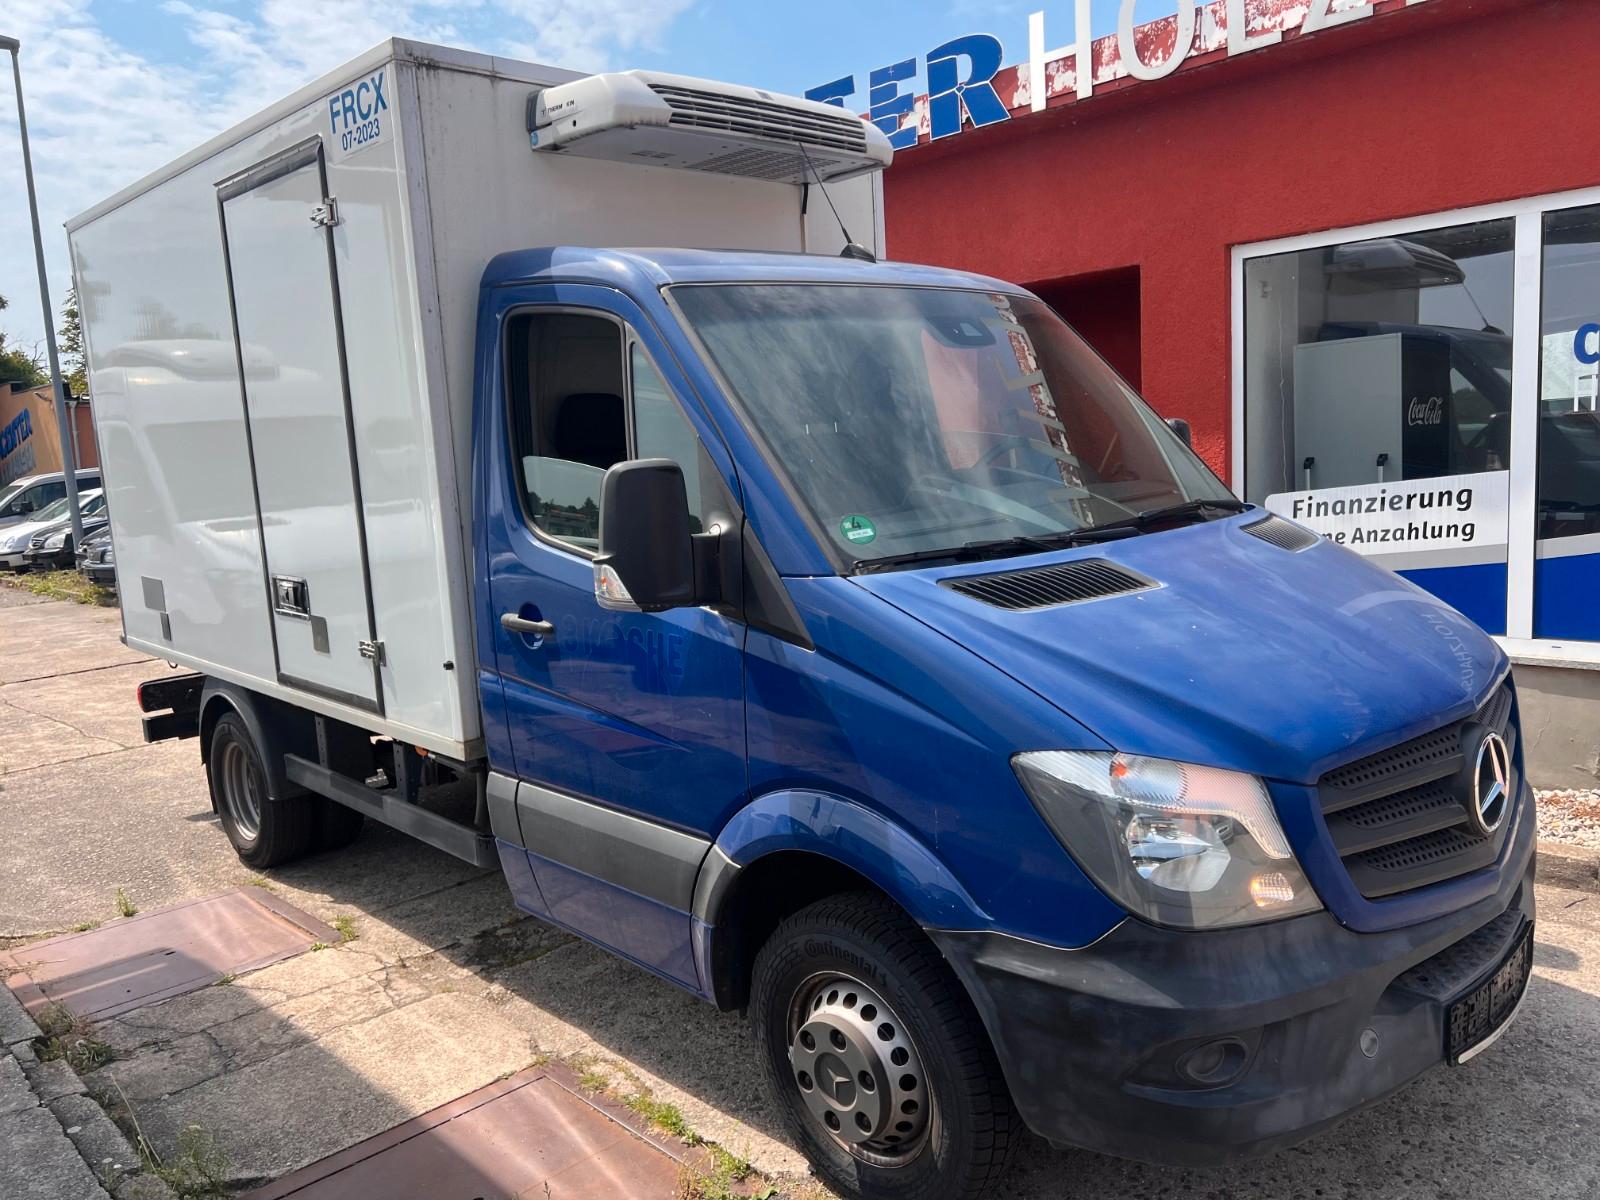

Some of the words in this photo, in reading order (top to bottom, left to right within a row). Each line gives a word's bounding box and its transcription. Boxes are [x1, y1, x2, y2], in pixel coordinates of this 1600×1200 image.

[329, 72, 387, 134] FRCX
[342, 118, 380, 151] 07-2023
[1293, 488, 1473, 519] Finanzierung
[1351, 521, 1476, 545] Anzahlung
